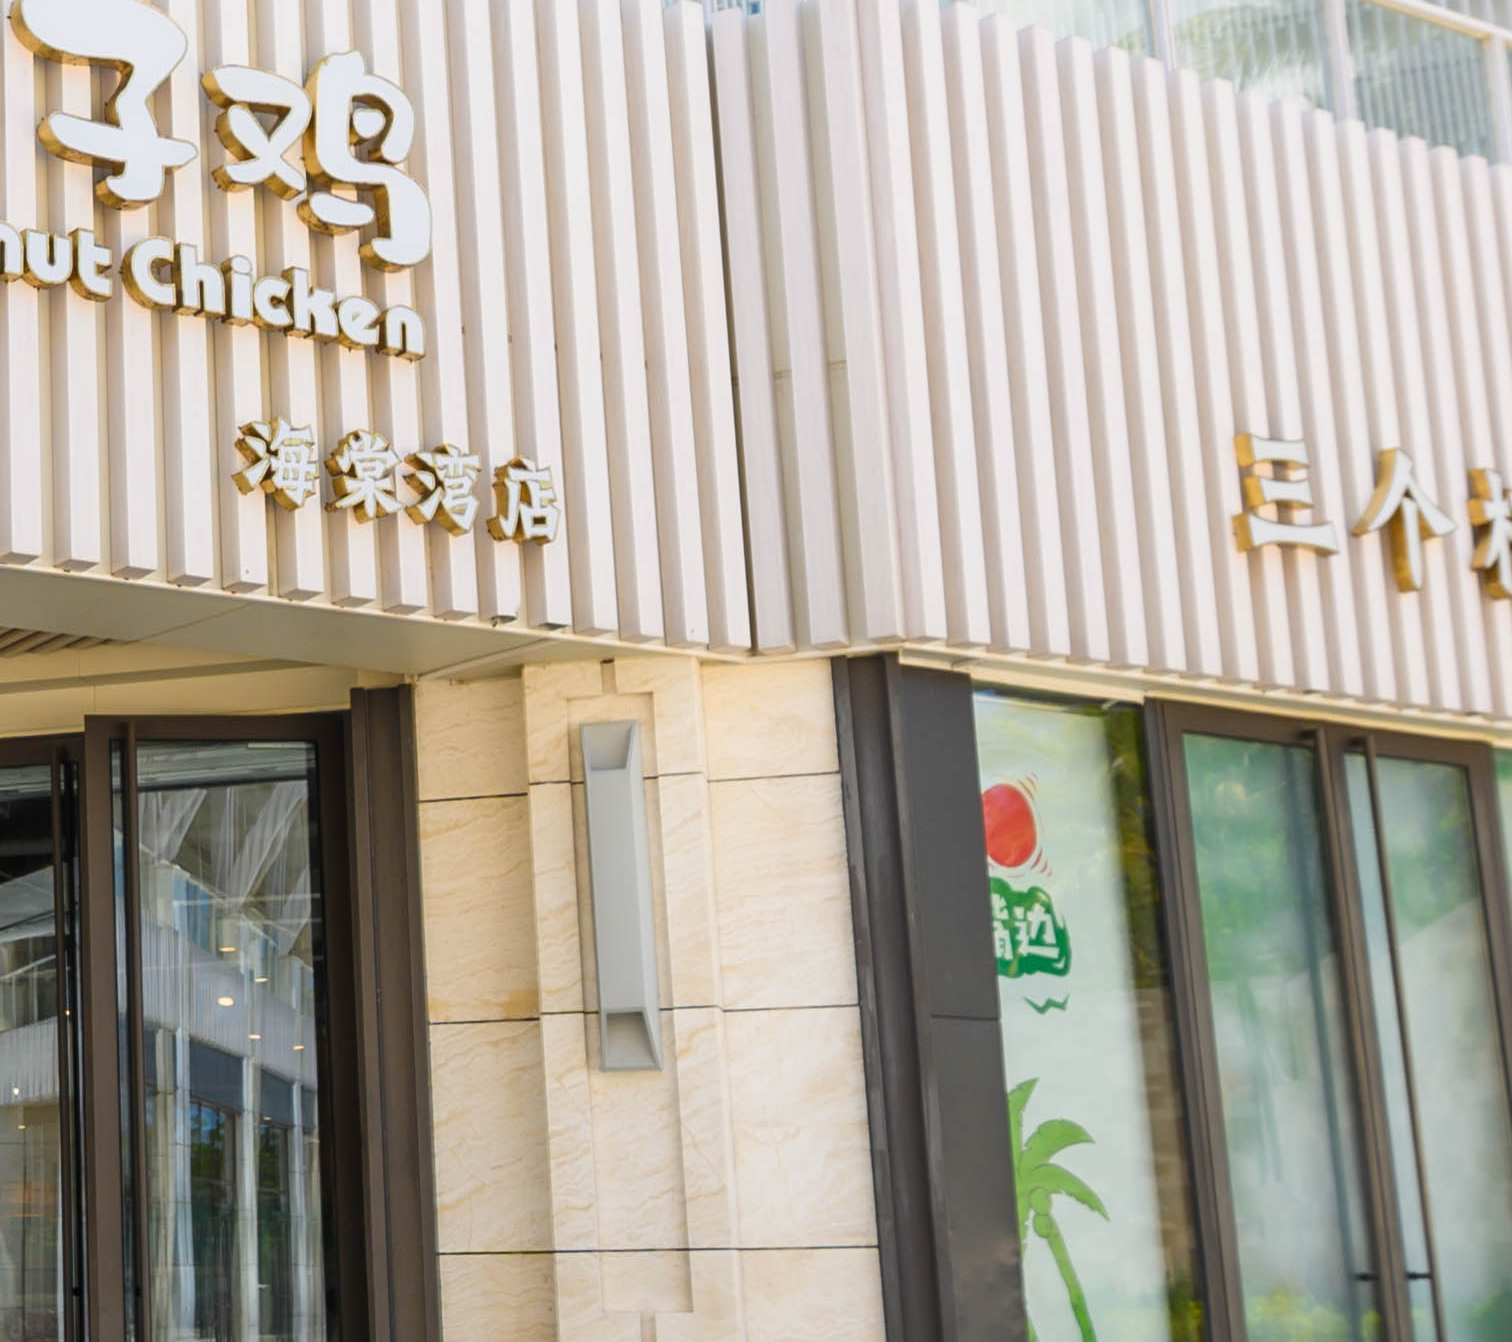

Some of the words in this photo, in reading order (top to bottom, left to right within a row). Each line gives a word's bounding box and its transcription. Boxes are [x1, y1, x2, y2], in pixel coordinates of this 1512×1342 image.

[119, 237, 428, 363] Chicken
[231, 416, 564, 545] 海棠湾店
